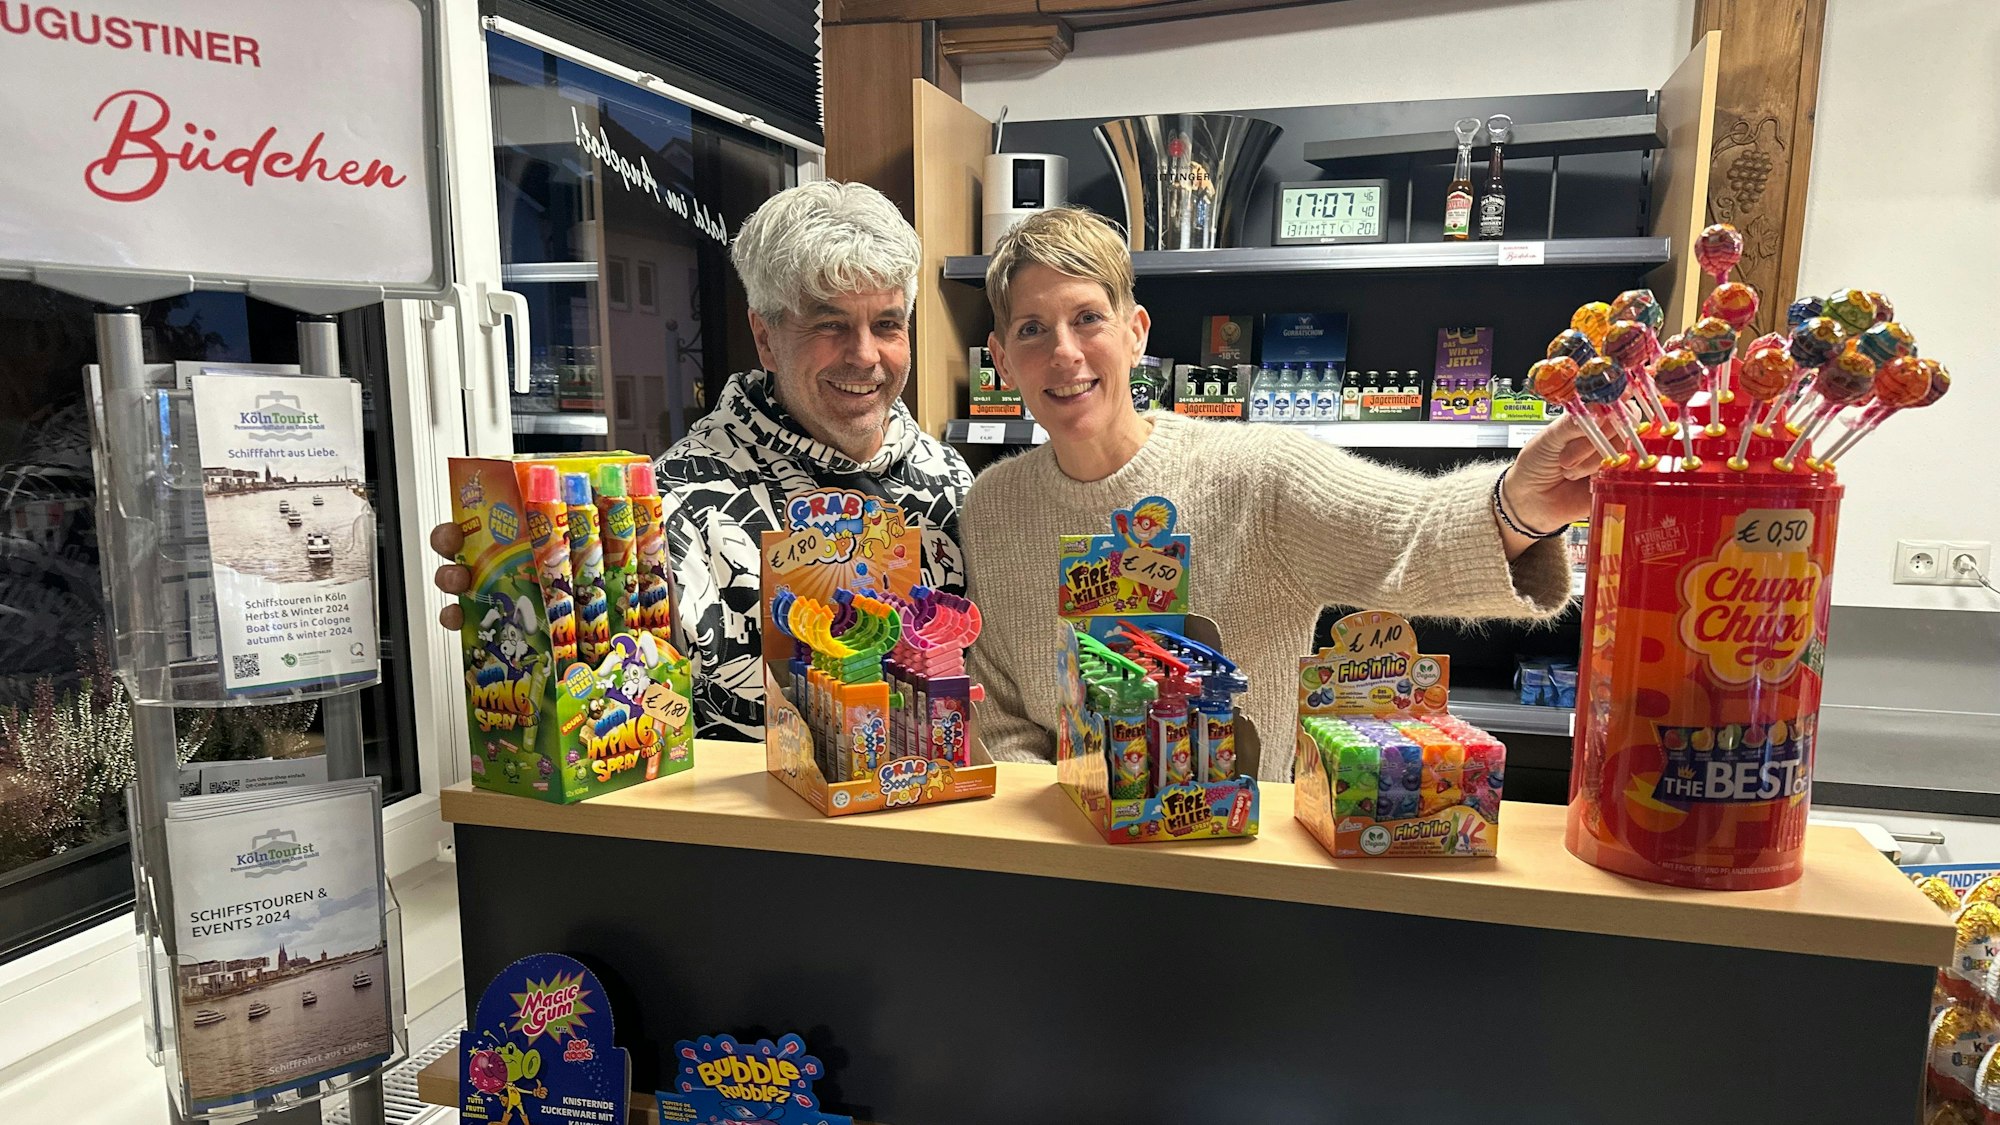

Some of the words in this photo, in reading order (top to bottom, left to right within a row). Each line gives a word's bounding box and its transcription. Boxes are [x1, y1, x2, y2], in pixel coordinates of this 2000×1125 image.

[85, 89, 407, 202] Büdchen
[1295, 192, 1355, 218] 17:07
[1362, 205, 1375, 217] 40
[1448, 347, 1468, 356] WIR
[1446, 356, 1482, 368] JETZT.
[240, 412, 320, 424] KölnTourist
[227, 449, 286, 459] Schifffahrt
[287, 450, 306, 458] aus
[307, 448, 339, 458] Liebe.
[790, 495, 861, 520] GRAB
[1635, 526, 1680, 545] NATÜRLICH
[1738, 520, 1761, 544] €
[1768, 519, 1808, 548] 0,50
[771, 552, 785, 569] €
[787, 535, 817, 562] 1,80
[823, 537, 852, 560] OP
[1122, 555, 1139, 571] €
[1142, 565, 1177, 581] 1,50
[1704, 566, 1816, 610] Chupa
[245, 596, 312, 610] Schiffstouren
[313, 594, 323, 603] in
[325, 592, 347, 602] Köln
[245, 611, 279, 622] Herbst
[281, 609, 289, 618] &
[290, 607, 324, 617] Winter
[326, 603, 350, 614] 2024
[246, 624, 271, 634] Boat
[272, 621, 298, 632] tours
[300, 619, 309, 628] in
[311, 616, 351, 627] Cologne
[1693, 604, 1809, 662] Chups
[246, 635, 286, 646] autumn
[287, 632, 295, 641] &
[296, 630, 328, 640] winter
[329, 626, 353, 637] 2024
[1349, 632, 1364, 653] €
[1370, 624, 1403, 650] 1,10
[566, 668, 590, 688] SUGAR
[570, 675, 594, 697] FREE!
[646, 693, 662, 708] €
[660, 700, 687, 718] 1,80
[562, 713, 583, 733] SOUR!
[591, 749, 641, 783] SPRAY
[880, 760, 925, 780] GRAB
[1664, 776, 1704, 798] THE
[1704, 759, 1800, 800] BEST
[888, 787, 920, 805] POP
[236, 843, 314, 866] KölnTourist
[190, 890, 314, 923] SCHIFFSTOUREN
[317, 888, 328, 899] &
[192, 917, 253, 938] EVENTS
[256, 909, 291, 926] 2024
[324, 1049, 342, 1062] aus
[343, 1041, 372, 1055] Liebe.
[564, 1050, 592, 1061] ROCKS
[568, 1040, 588, 1051] POP
[465, 1104, 486, 1113] FRUTTI
[467, 1096, 484, 1105] TUTTI
[562, 1096, 615, 1111] KNISTERNDE
[540, 1105, 597, 1120] ZUCKERWARE
[598, 1113, 615, 1122] MIT
